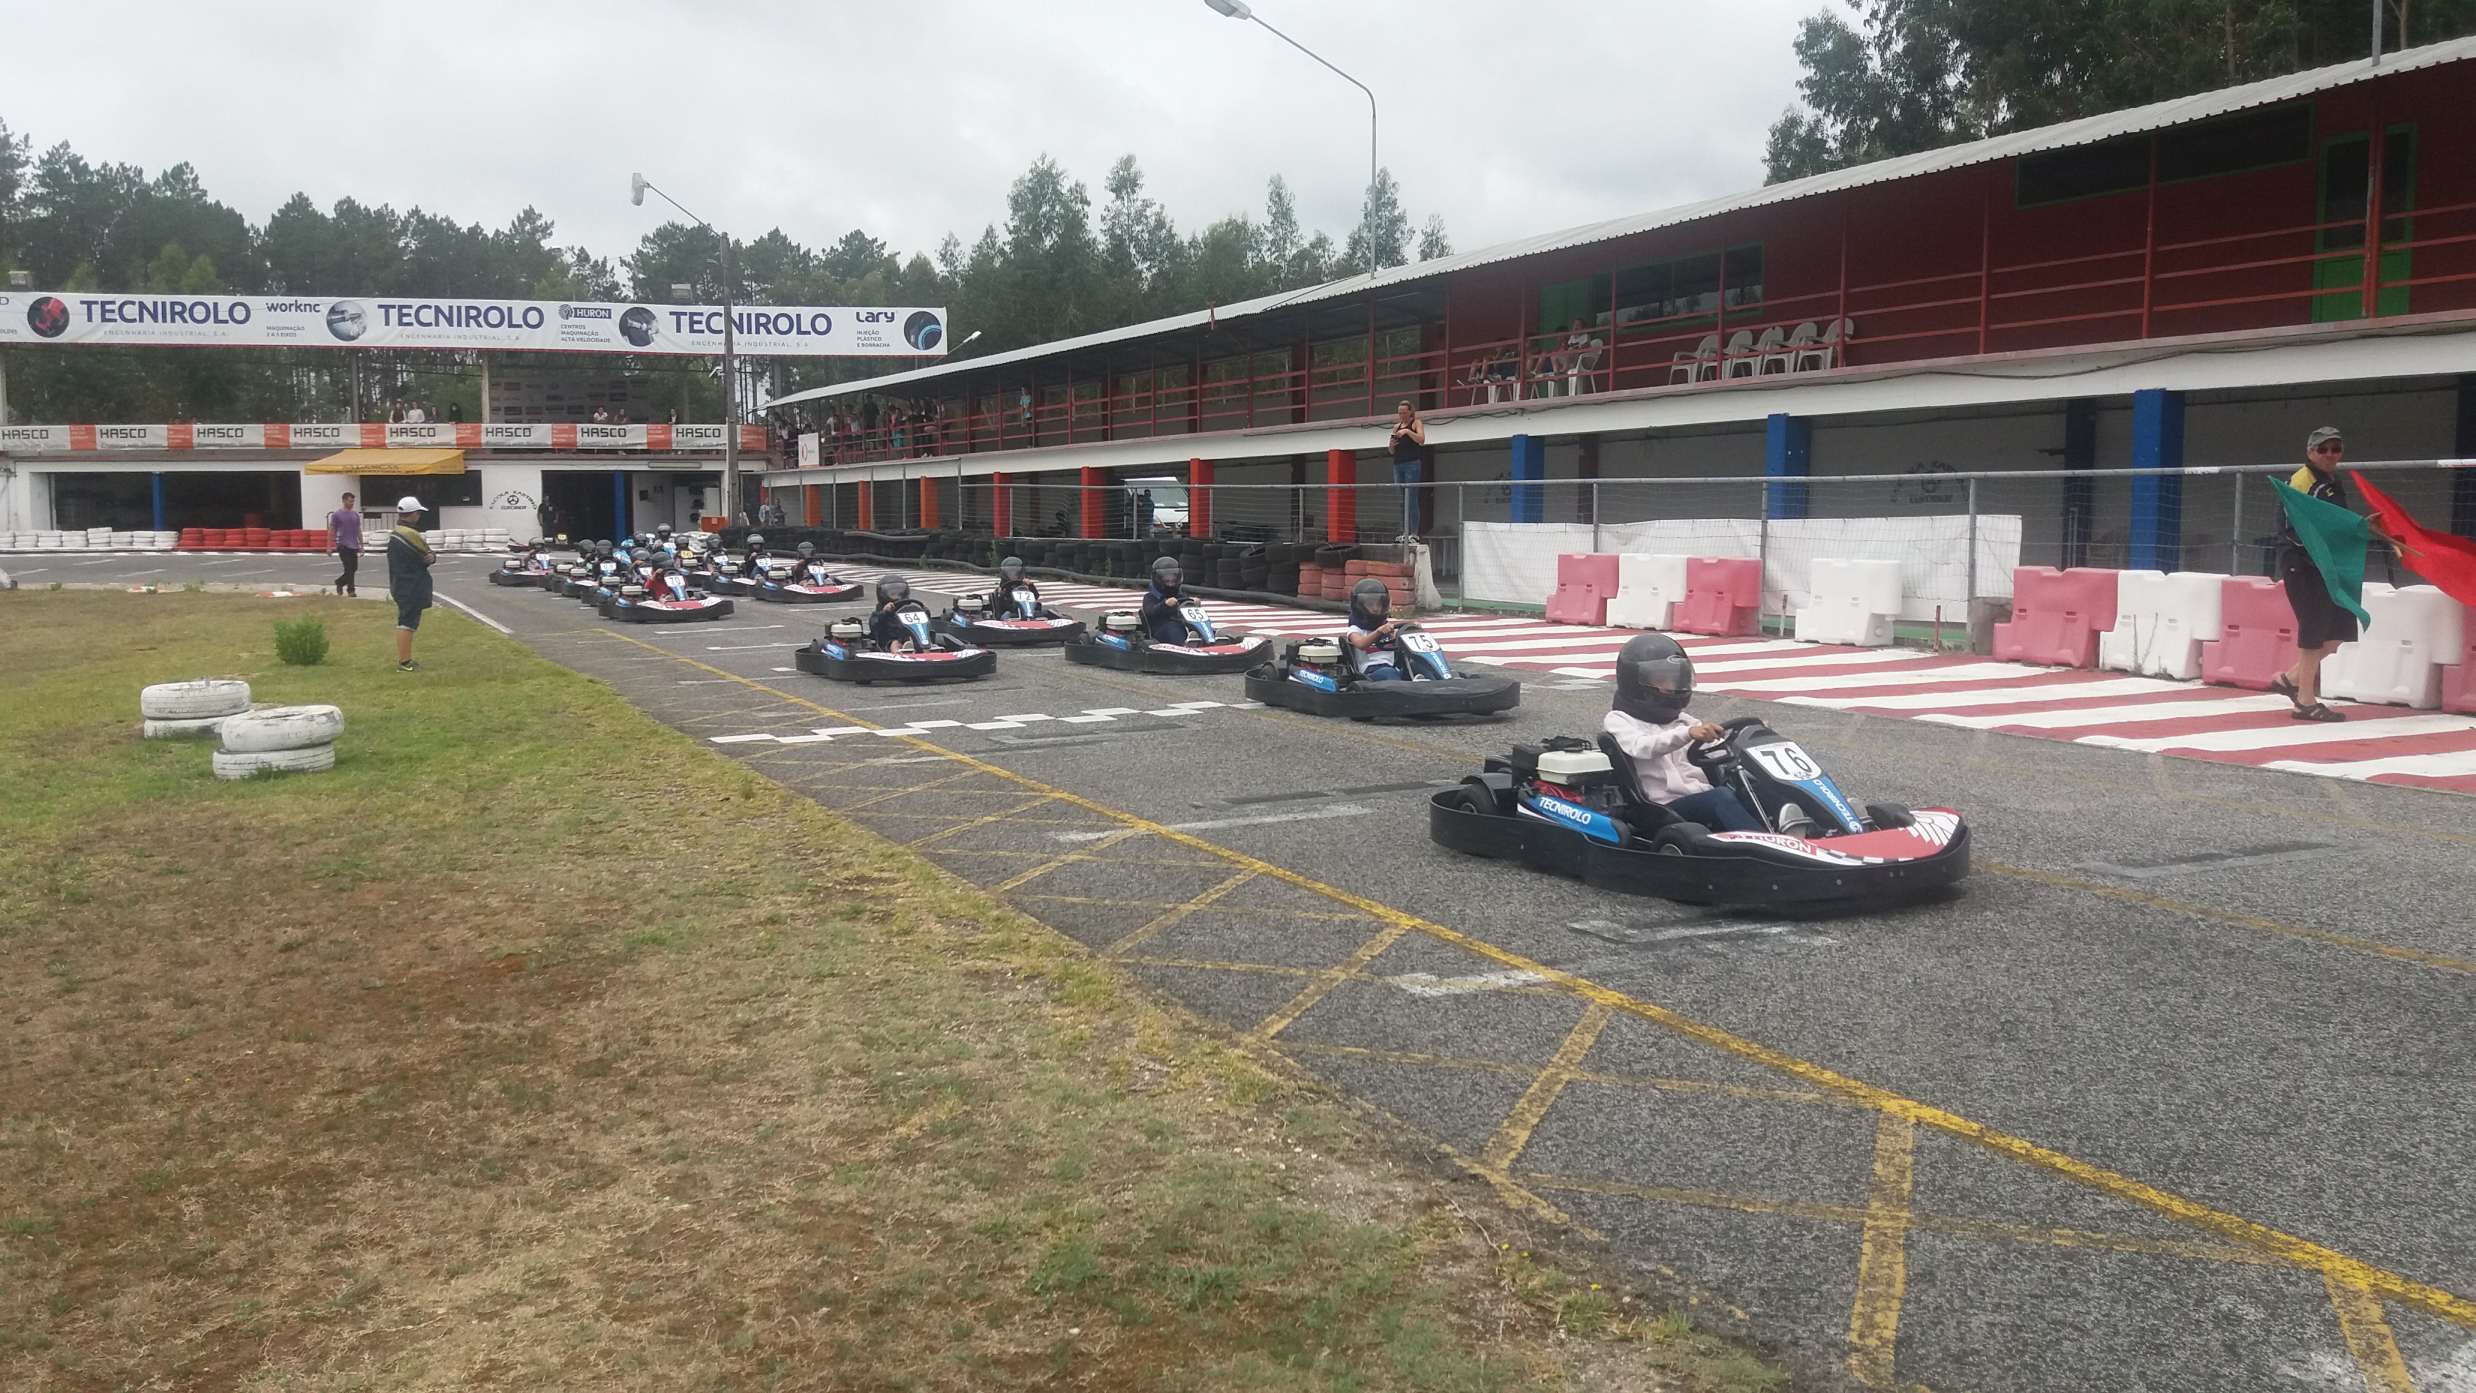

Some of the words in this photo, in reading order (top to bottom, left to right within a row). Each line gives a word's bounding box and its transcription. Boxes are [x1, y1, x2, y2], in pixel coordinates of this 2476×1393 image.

[265, 299, 321, 313] worknc
[80, 300, 250, 325] TECNIROLO
[377, 304, 544, 329] TECNIROLO
[577, 307, 609, 319] HURON
[668, 311, 833, 336] TECNIROLO
[2, 429, 49, 440] HASCO
[100, 428, 147, 439] HASCO
[197, 427, 244, 438] HASCO
[294, 427, 341, 438] HASCO
[390, 427, 436, 437] HASCO
[485, 427, 532, 438] HASCO
[581, 427, 627, 438] HASCO
[676, 427, 721, 438] HASCO
[904, 613, 921, 623] 64
[1408, 632, 1434, 649] 75
[1759, 747, 1812, 775] 76
[1540, 796, 1592, 825] TECNIROLO
